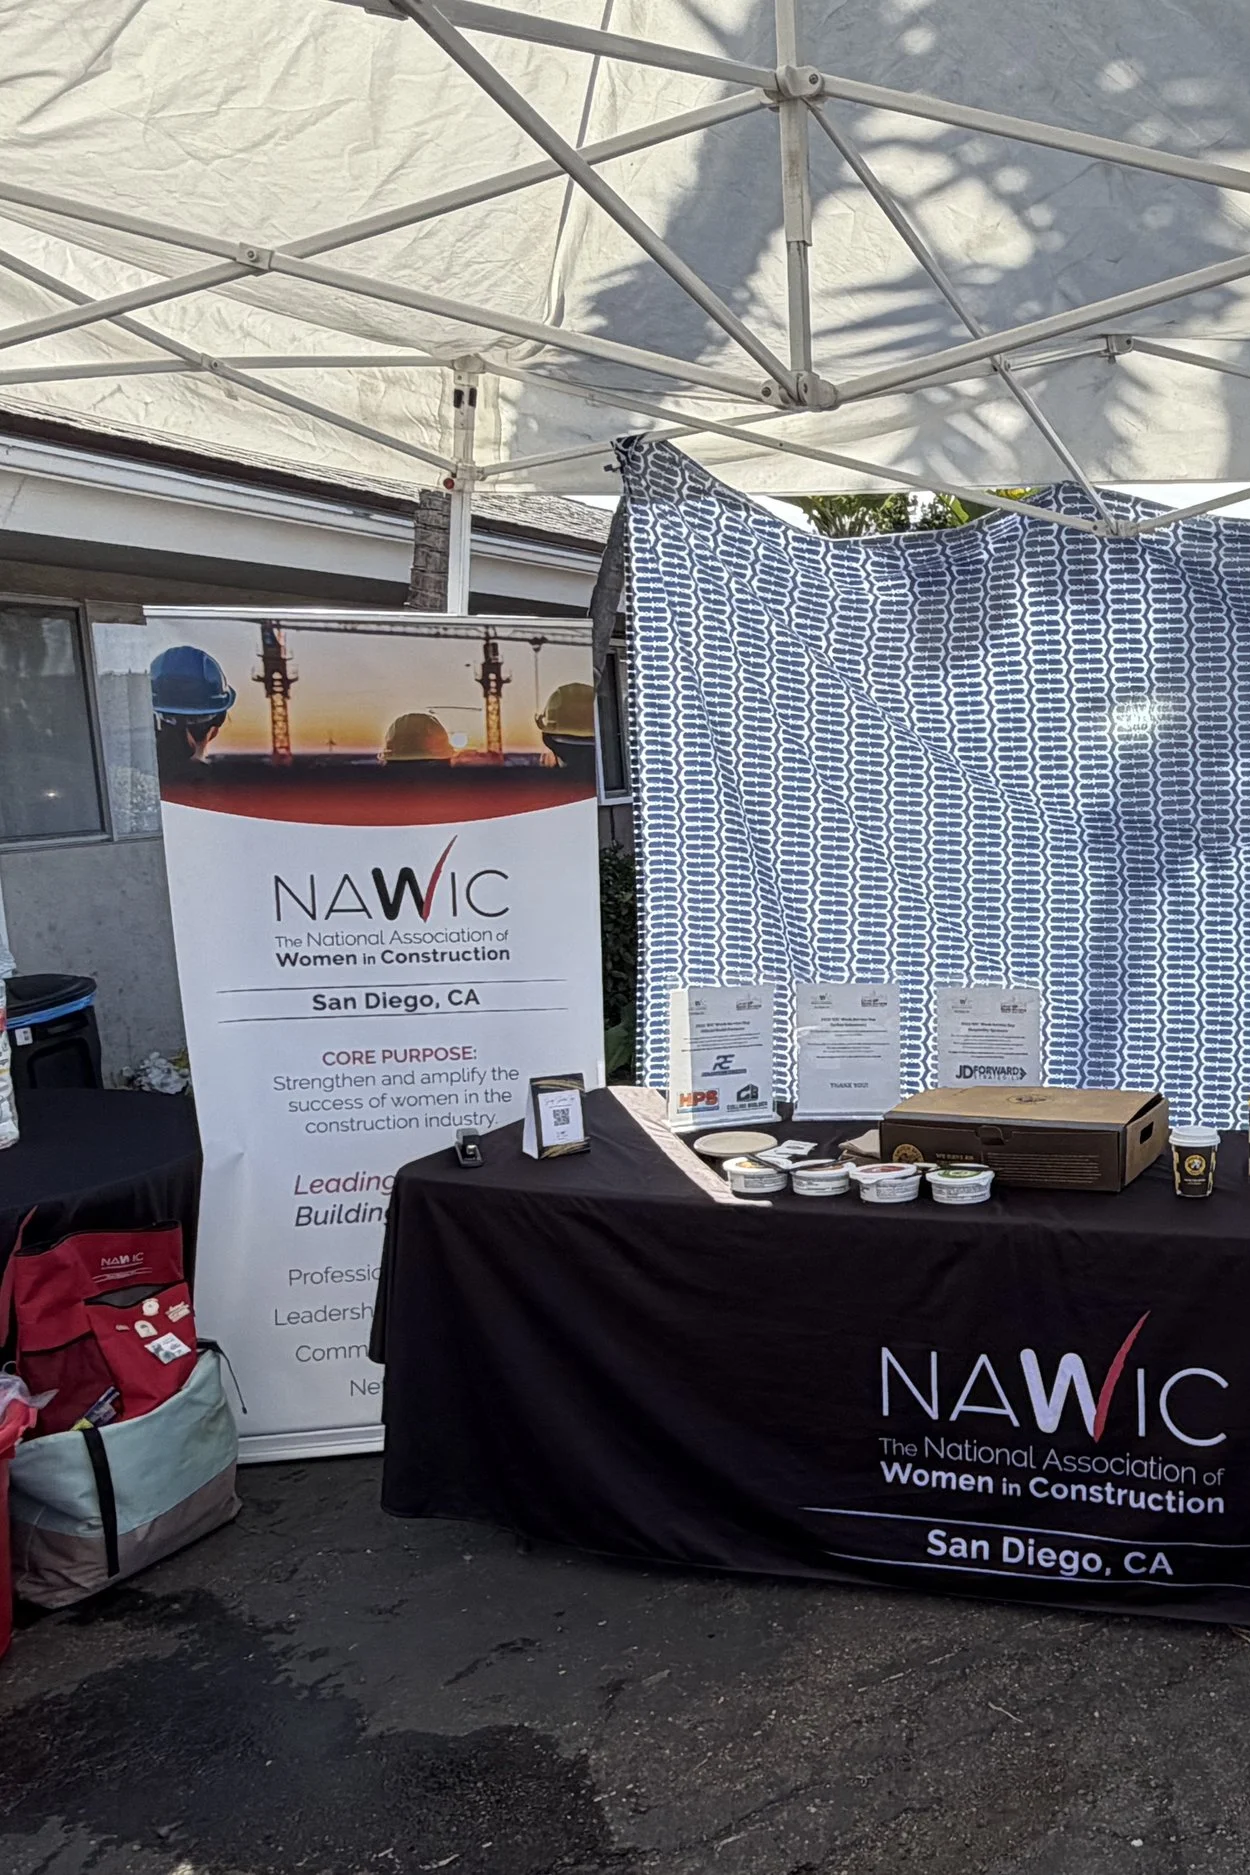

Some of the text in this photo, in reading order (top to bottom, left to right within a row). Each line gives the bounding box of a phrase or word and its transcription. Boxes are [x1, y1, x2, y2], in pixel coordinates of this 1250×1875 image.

[274, 835, 509, 923] NAWIC
[274, 928, 509, 948] The National Association of
[275, 947, 510, 967] Women in Construction
[312, 989, 480, 1012] San Diego, CA
[322, 1046, 477, 1066] CORE PURPOSE:
[273, 1066, 519, 1092] Strengthen and amplify the
[288, 1089, 512, 1112] success of women in the
[305, 1111, 499, 1134] construction industry.
[294, 1171, 396, 1195] Leading
[101, 1252, 144, 1266] NAWIC
[350, 1378, 384, 1396] Ne
[881, 1310, 1229, 1447] NAWIC
[878, 1436, 1225, 1487] The National Association of
[879, 1461, 1225, 1515] Women in Construction
[927, 1529, 1174, 1577] San Diego, CA
